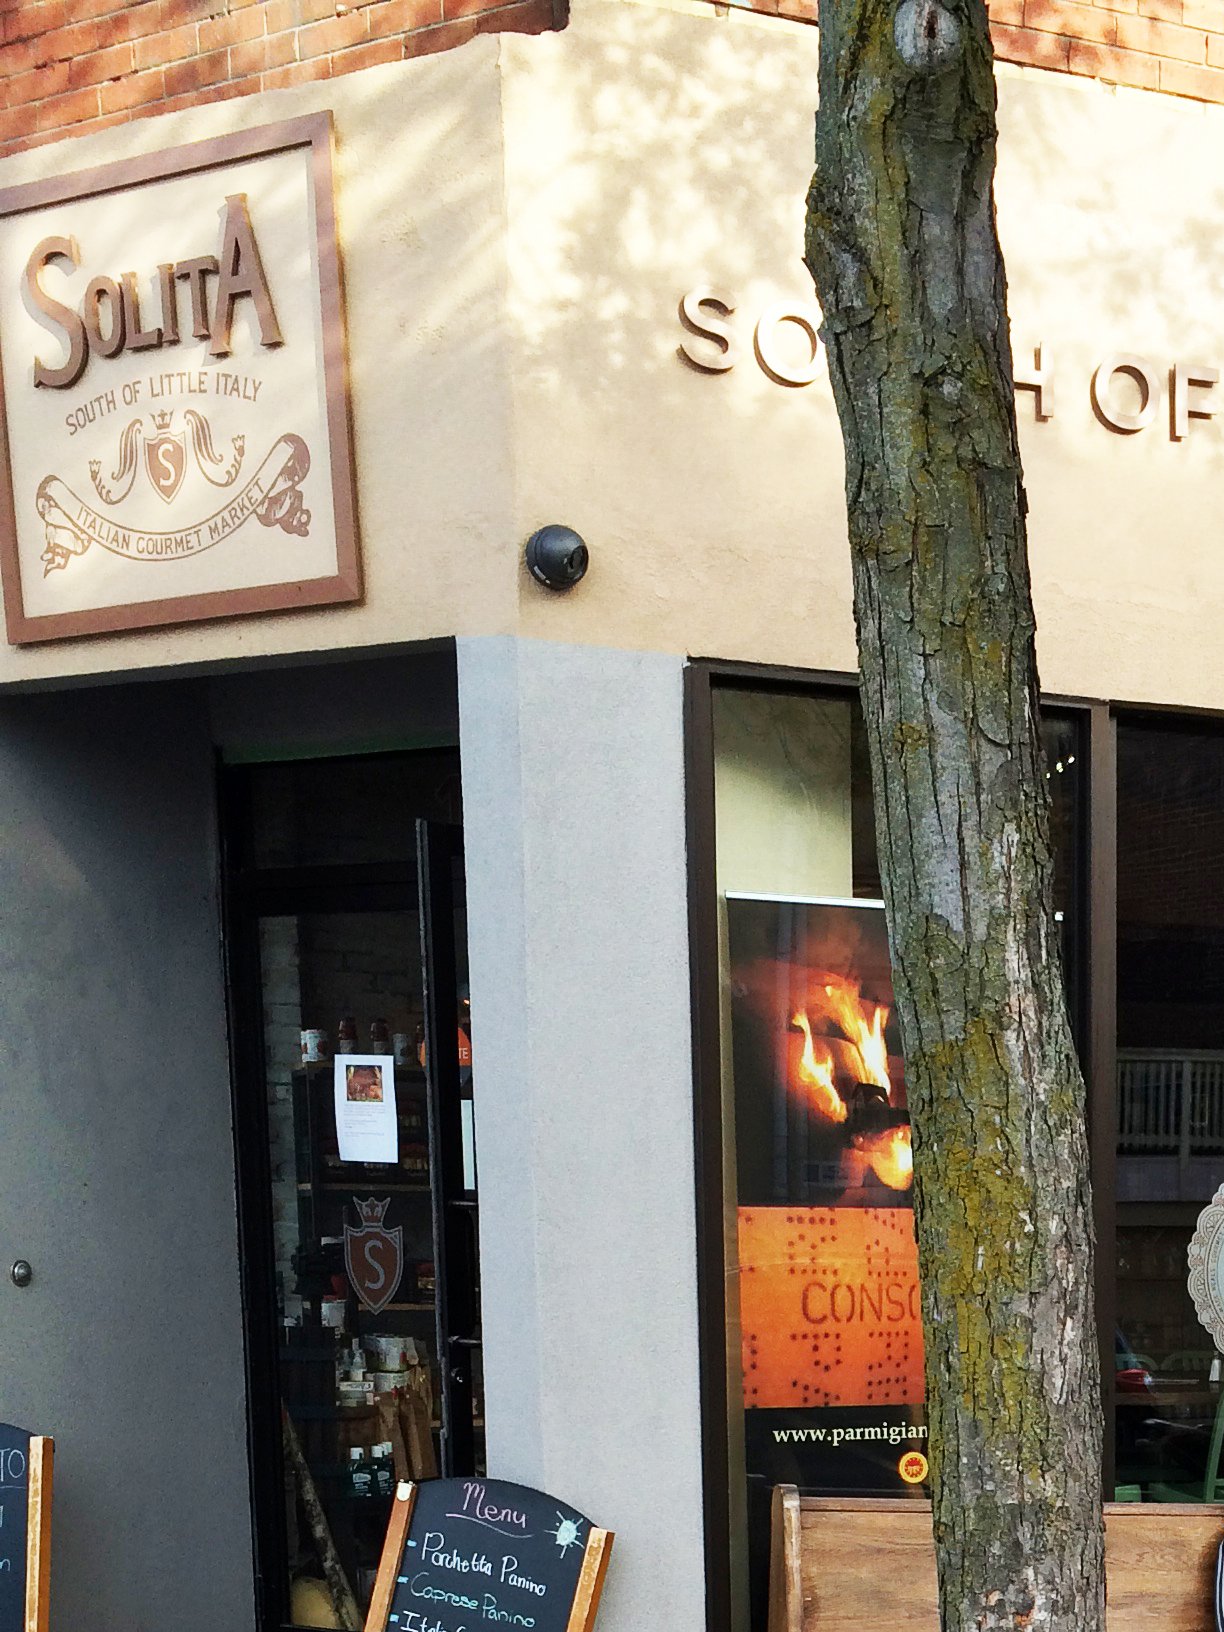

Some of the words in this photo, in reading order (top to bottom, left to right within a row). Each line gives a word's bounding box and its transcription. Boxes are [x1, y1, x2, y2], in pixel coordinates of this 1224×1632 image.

[21, 193, 284, 390] SOLITA
[678, 284, 1053, 422] SOH
[1090, 351, 1220, 443] OF
[65, 389, 117, 436] SOUTH
[122, 380, 142, 406] OF
[149, 371, 208, 398] LITTLE
[215, 372, 263, 402] ITALY
[157, 443, 176, 487] S
[76, 507, 132, 551] ITALIAN
[136, 528, 202, 555] GOURMET
[208, 477, 265, 540] MARKET
[363, 1239, 386, 1290] S
[462, 1482, 527, 1528] Menu
[421, 1532, 493, 1576] Porchetta
[500, 1555, 547, 1597] Panino
[410, 1572, 479, 1610] Caprese
[482, 1593, 535, 1628] Panino
